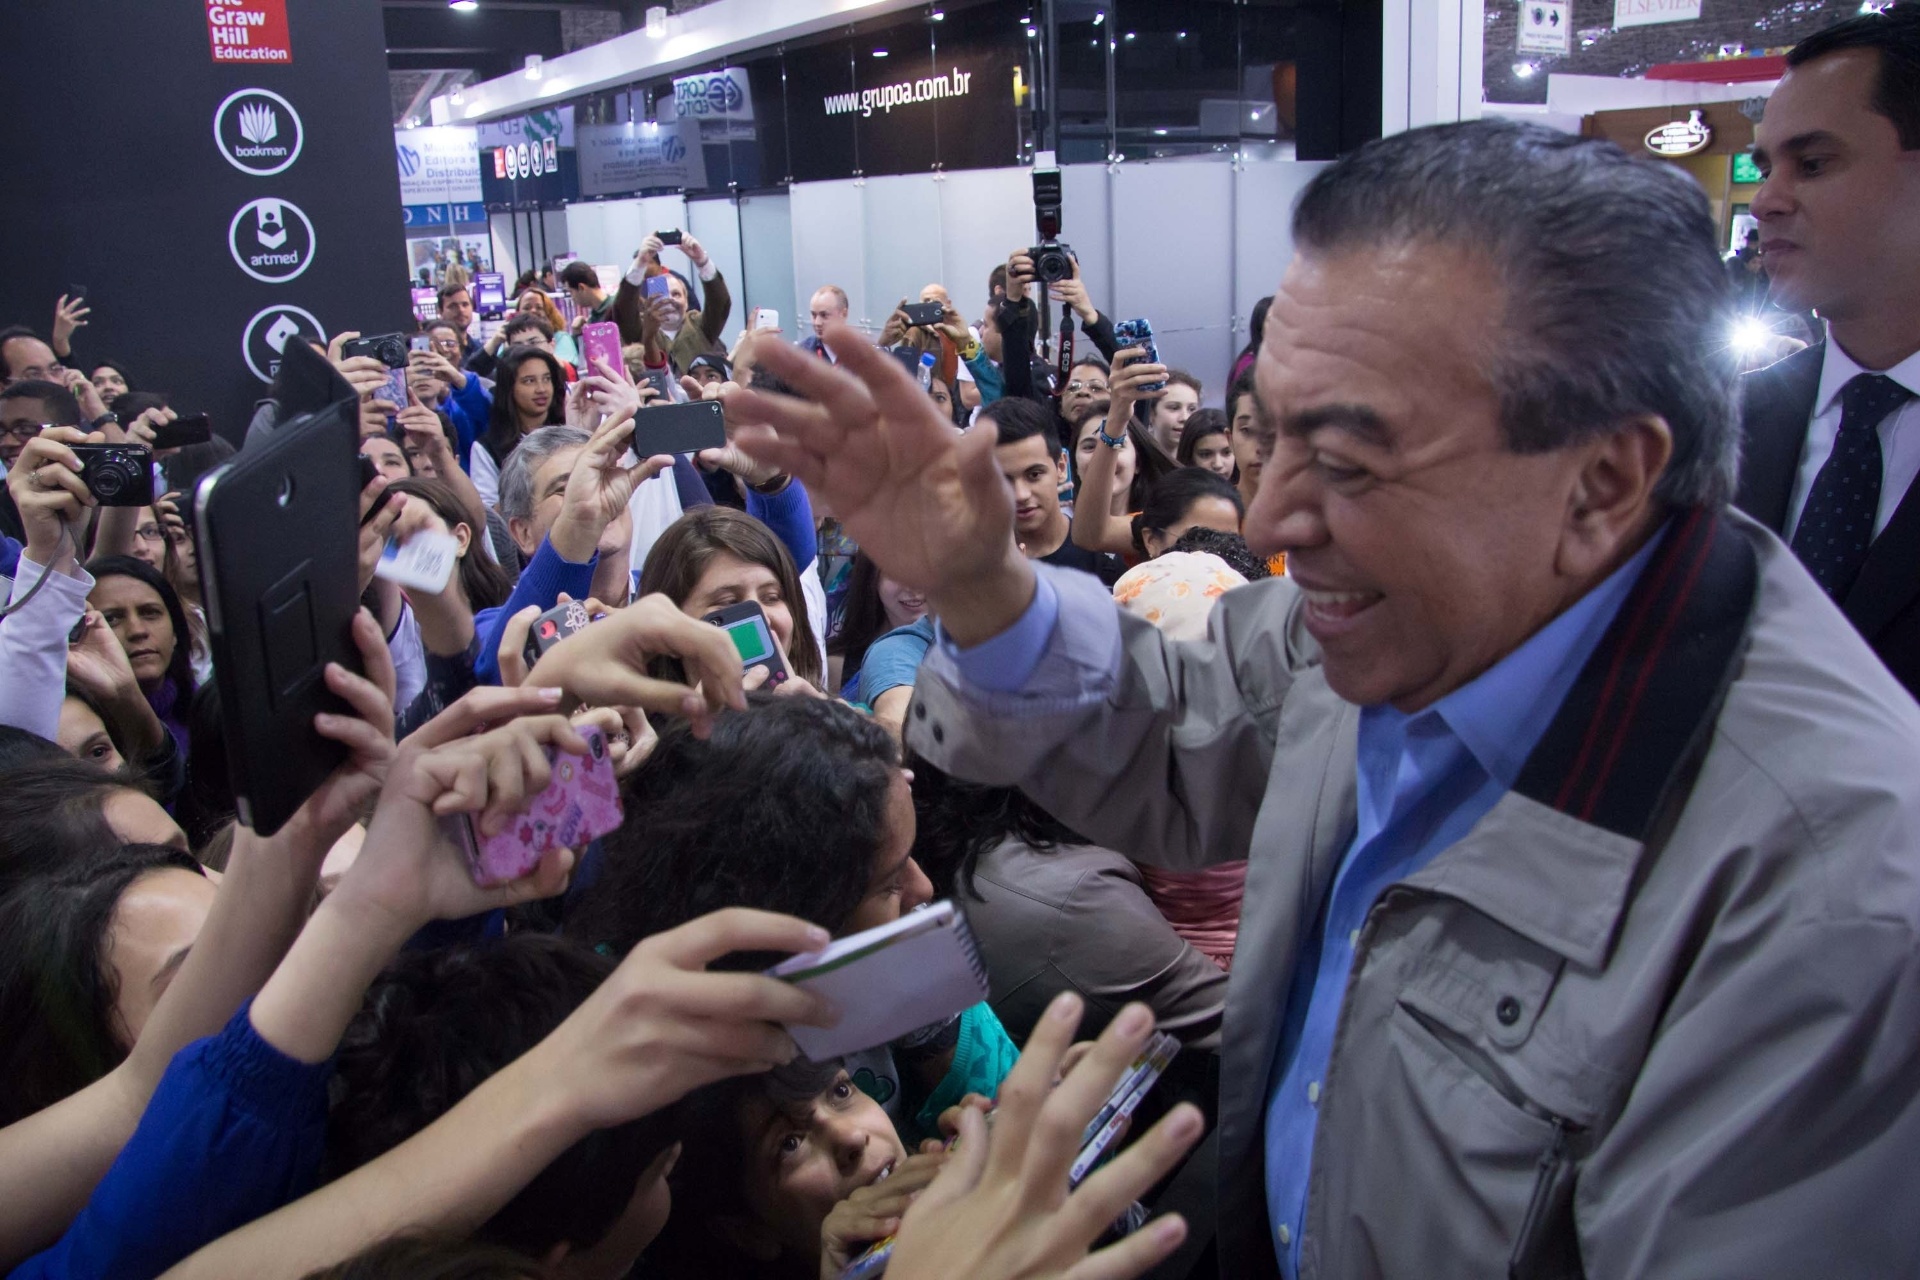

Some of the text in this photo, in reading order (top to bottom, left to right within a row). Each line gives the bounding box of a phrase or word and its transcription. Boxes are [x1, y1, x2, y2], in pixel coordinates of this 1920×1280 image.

[208, 6, 266, 26] Graw
[212, 27, 249, 45] Hill
[214, 46, 288, 60] Education
[823, 67, 972, 118] www.grupoa.com.br
[235, 145, 287, 157] bookman
[425, 155, 466, 166] Editora
[250, 250, 298, 266] artmed
[1062, 340, 1071, 373] EOS 7D
